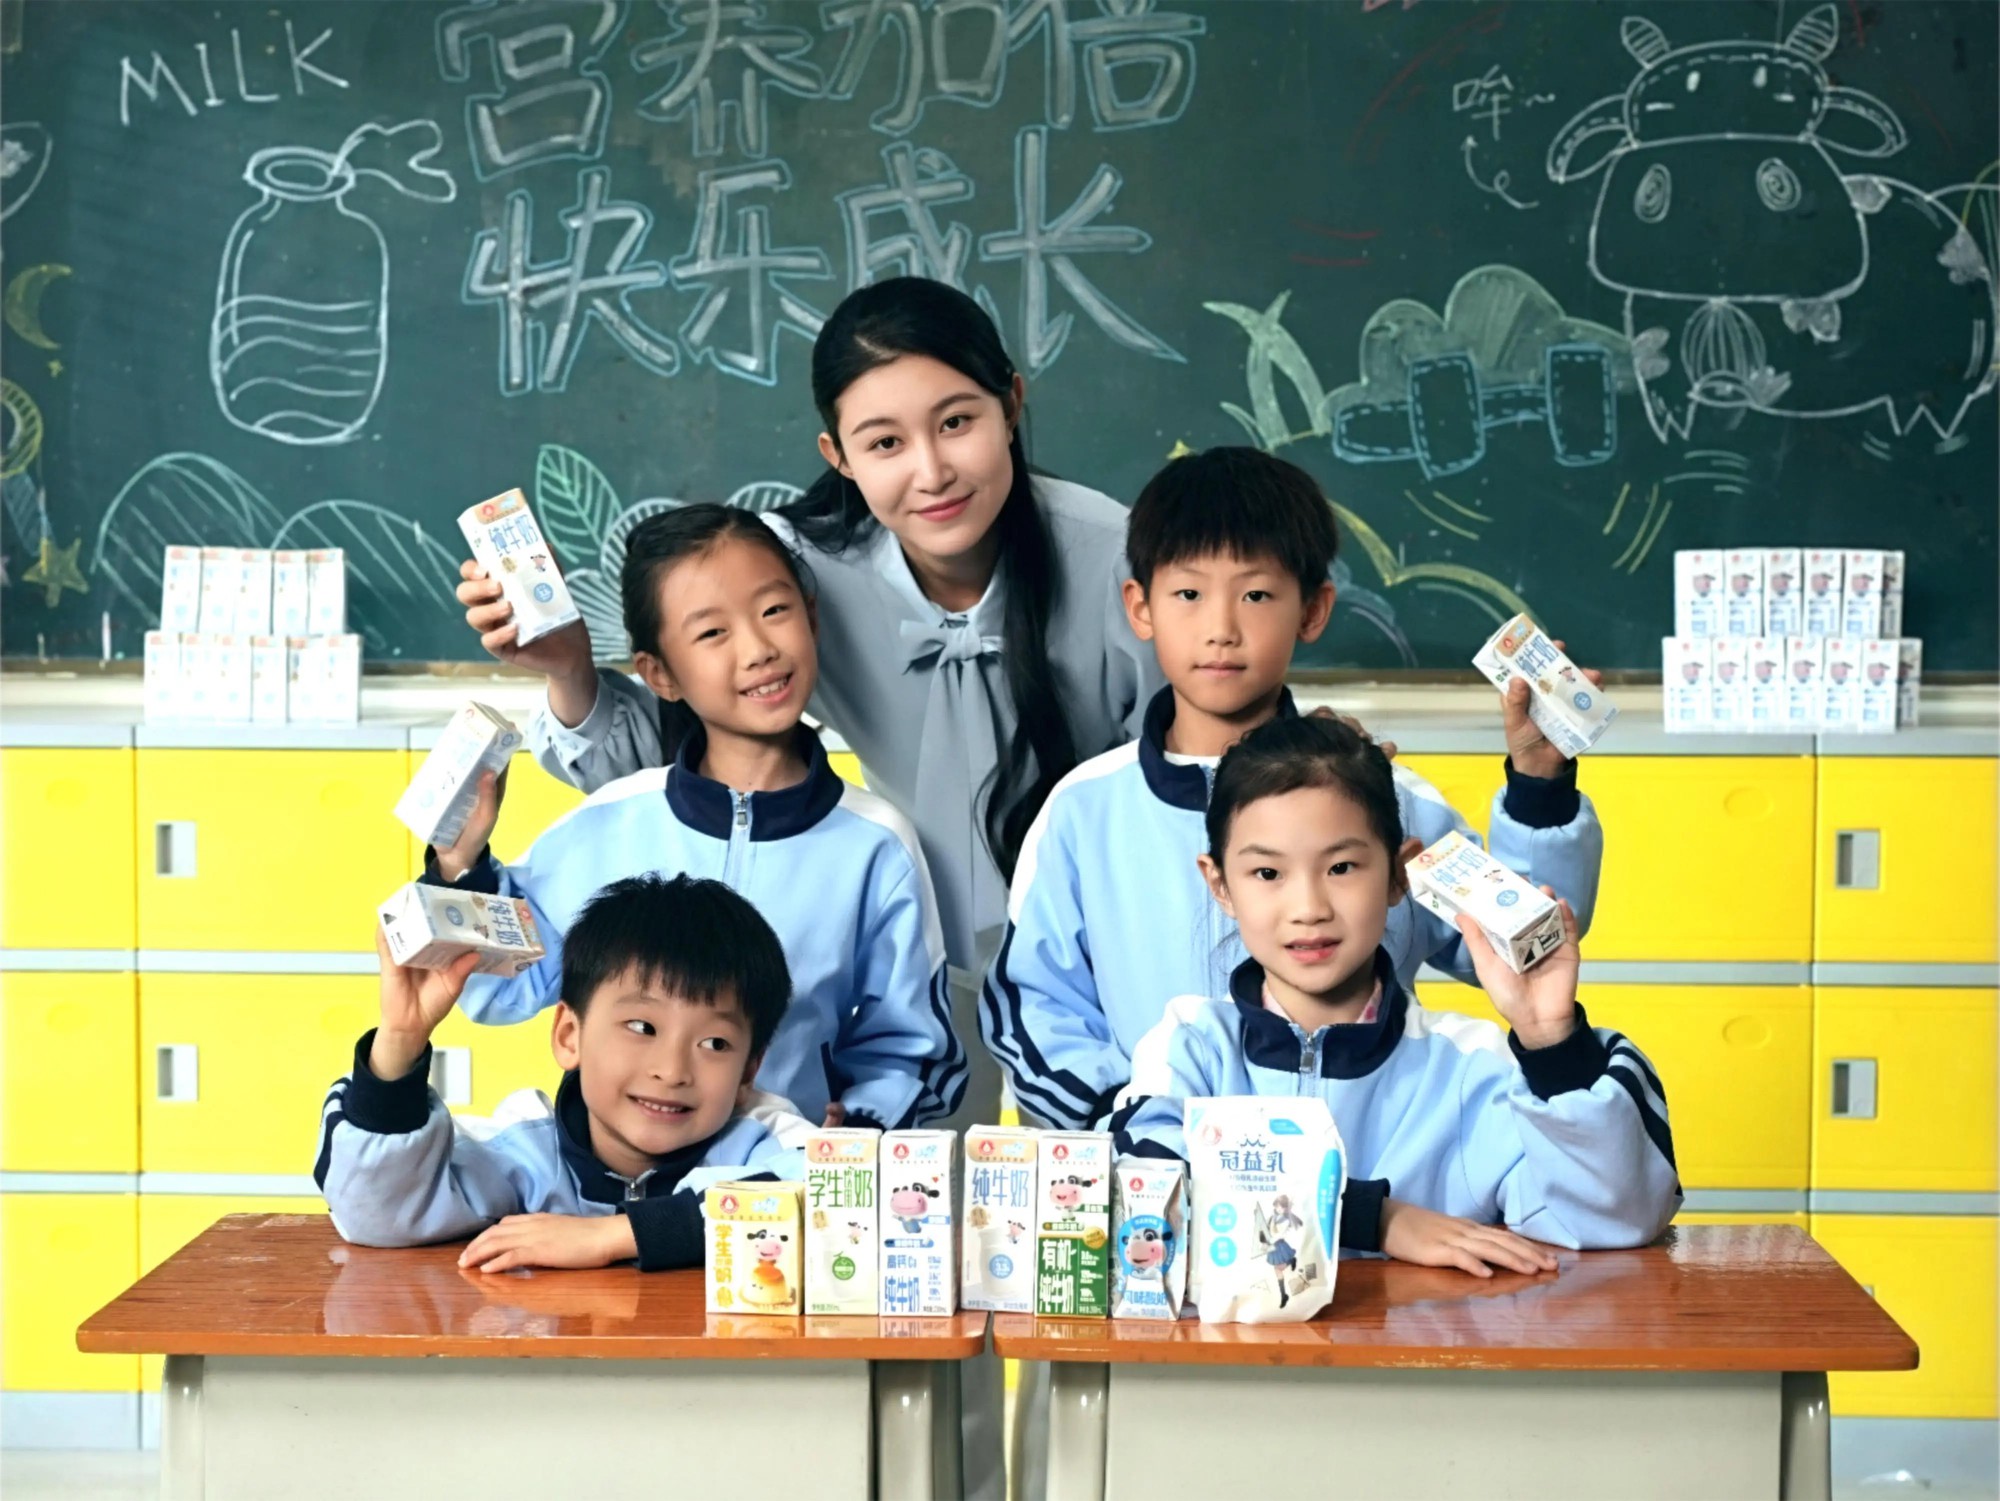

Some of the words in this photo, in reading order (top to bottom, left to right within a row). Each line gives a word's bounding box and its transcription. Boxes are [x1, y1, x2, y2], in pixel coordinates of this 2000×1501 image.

[118, 20, 350, 126] MILK
[487, 513, 539, 558] 纯牛奶
[1514, 634, 1560, 682] 纯牛奶
[1430, 847, 1488, 890] 纯牛奶
[1218, 1150, 1286, 1174] 冠益乳
[971, 1166, 1030, 1208] 纯牛奶
[1042, 1238, 1077, 1271] 有机
[883, 1275, 920, 1313] 纯牛奶
[1039, 1273, 1075, 1314] 纯牛奶
